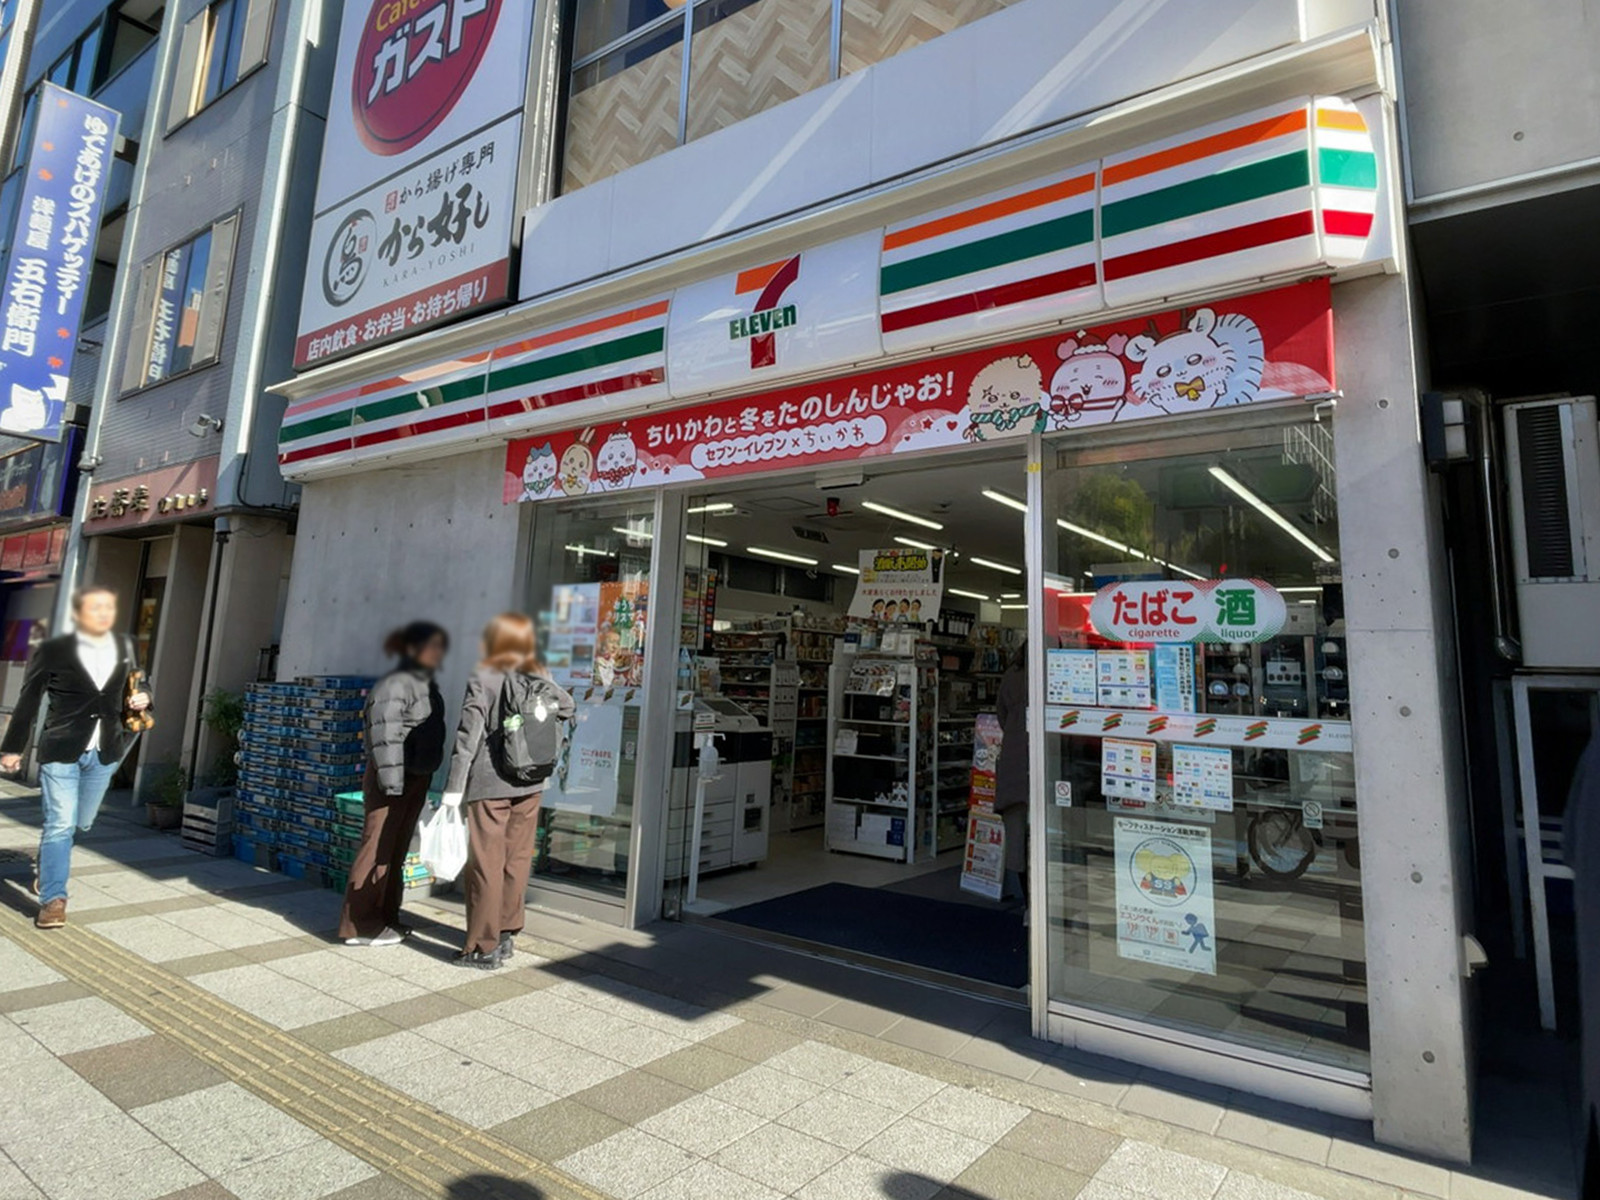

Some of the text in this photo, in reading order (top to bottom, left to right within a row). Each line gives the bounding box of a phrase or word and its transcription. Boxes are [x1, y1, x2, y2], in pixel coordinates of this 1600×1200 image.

[367, 0, 487, 106] ガスト
[399, 141, 495, 205] から揚げ専門
[377, 183, 490, 267] から好し
[2, 256, 48, 358] 五右衛門
[1112, 588, 1257, 626] たばこ 酒
[1128, 627, 1258, 640] cigarette liquor
